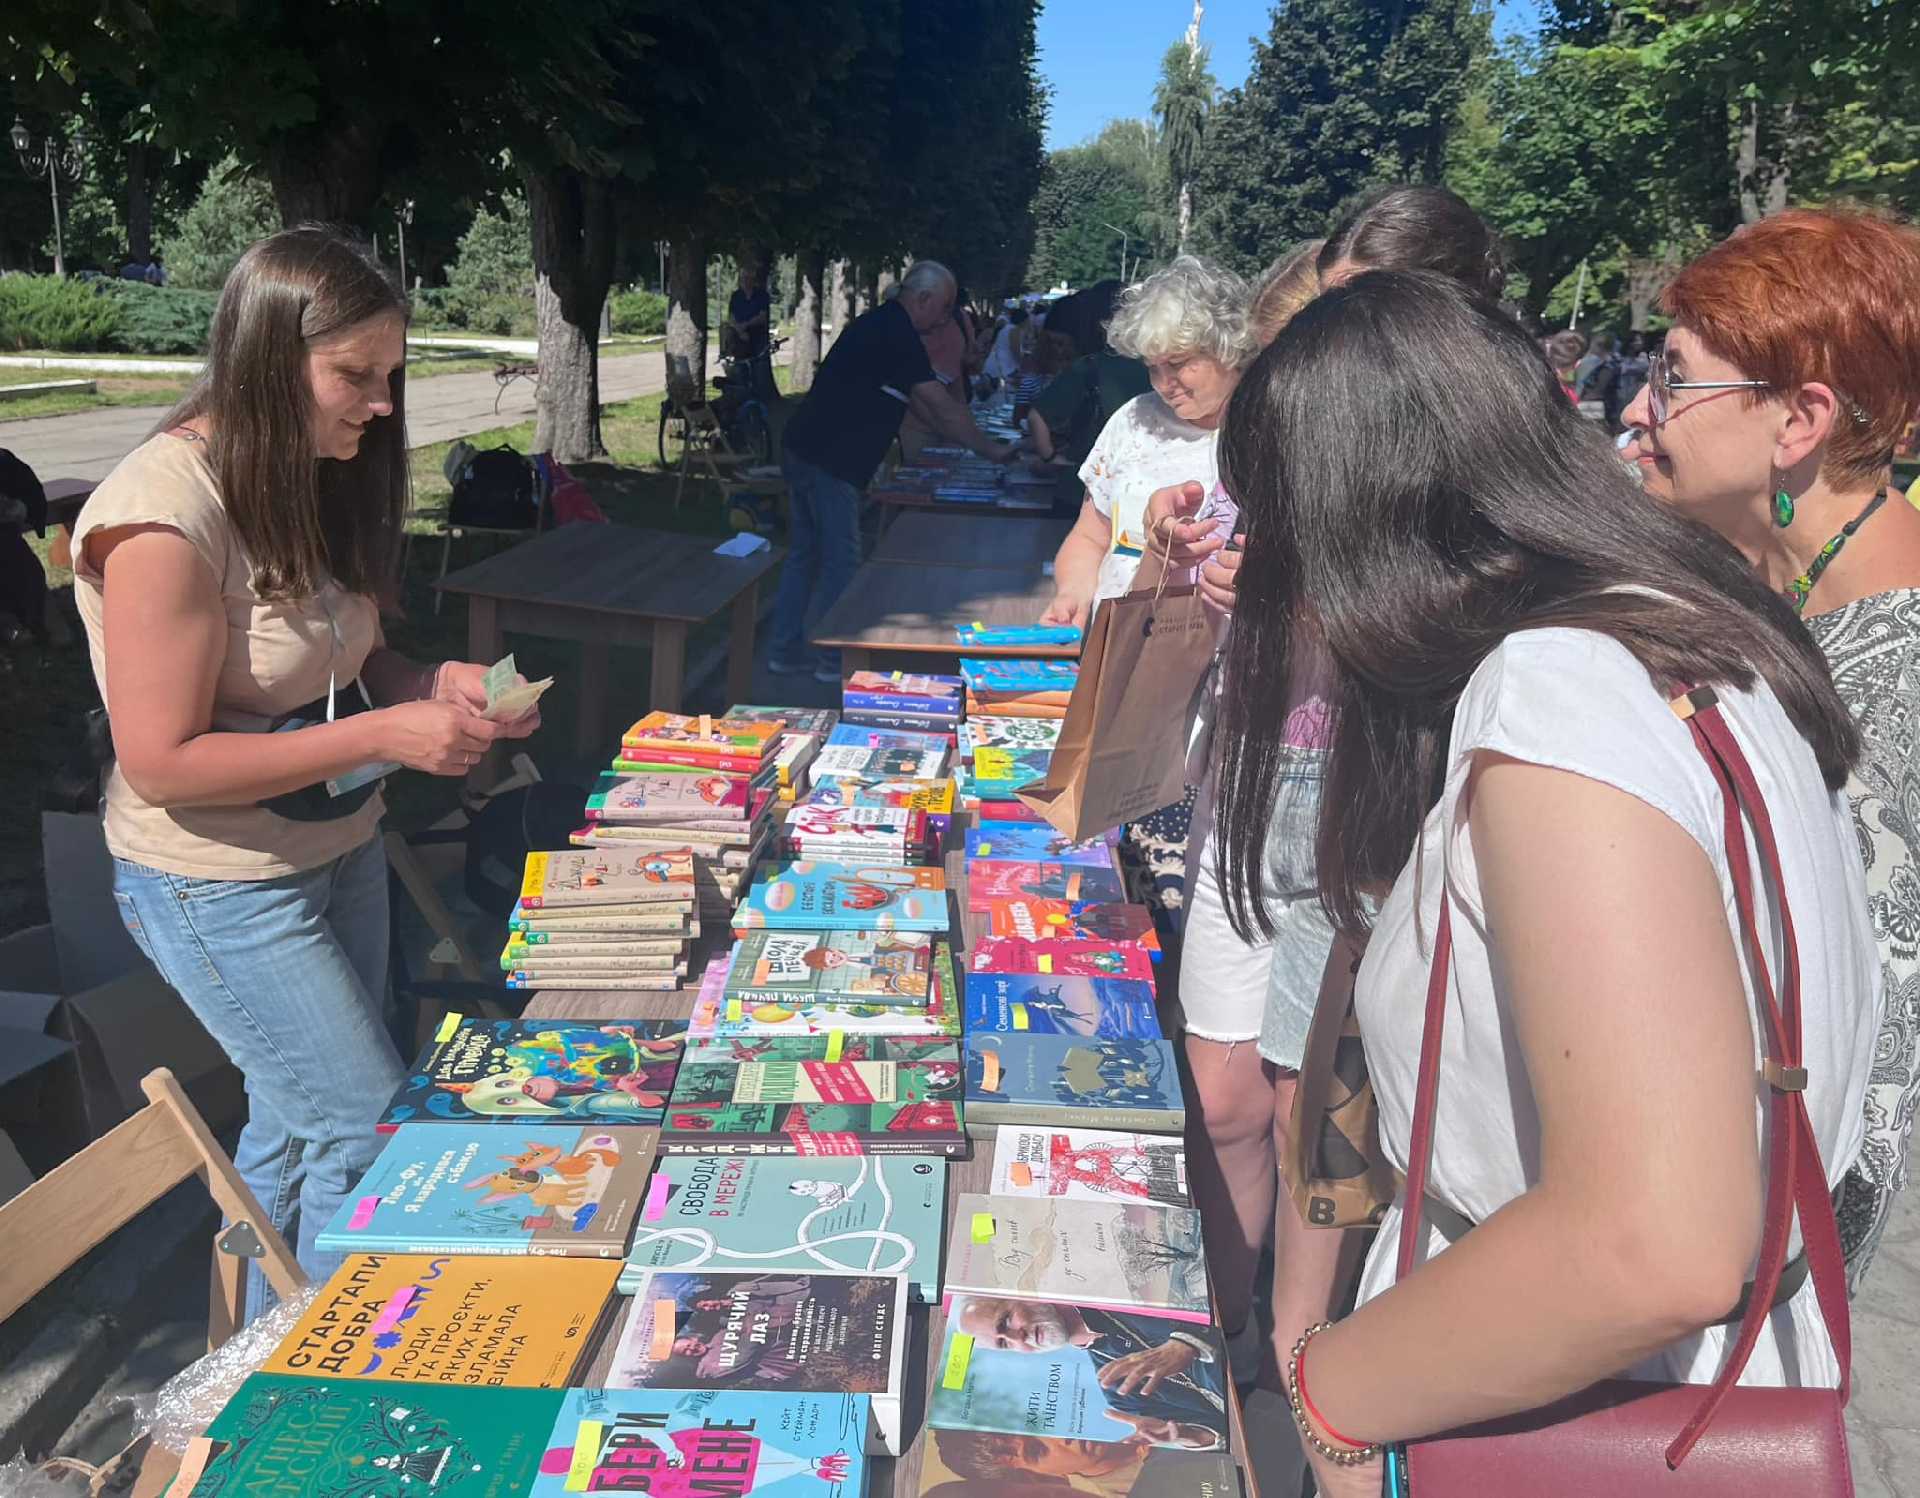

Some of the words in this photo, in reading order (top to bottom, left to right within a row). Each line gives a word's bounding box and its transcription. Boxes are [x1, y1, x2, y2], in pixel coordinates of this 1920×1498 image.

[680, 1156, 720, 1216] СВОБОДА
[708, 1209, 729, 1217] В
[713, 1158, 745, 1205] МЕРЕЖІ
[287, 1255, 387, 1369] СТАРТАПИ
[318, 1299, 386, 1373] ДОБРА
[415, 1360, 439, 1379] ТА
[431, 1278, 492, 1354] ПРОЄКТИ,
[464, 1304, 522, 1384] ЗЛАМАЛА
[718, 1290, 752, 1368] ЩУРЯЧИЙ
[750, 1312, 770, 1345] ЛАЗ
[390, 1327, 435, 1379] ЛЮДИ
[440, 1338, 478, 1381] ЯКИХ
[474, 1313, 493, 1333] НЕ
[487, 1335, 528, 1385] ВІЙНА
[1026, 1391, 1042, 1426] ЖИТИ
[1044, 1363, 1064, 1430] ТАЇНСТВОМ
[594, 1412, 669, 1492] БЕРИ
